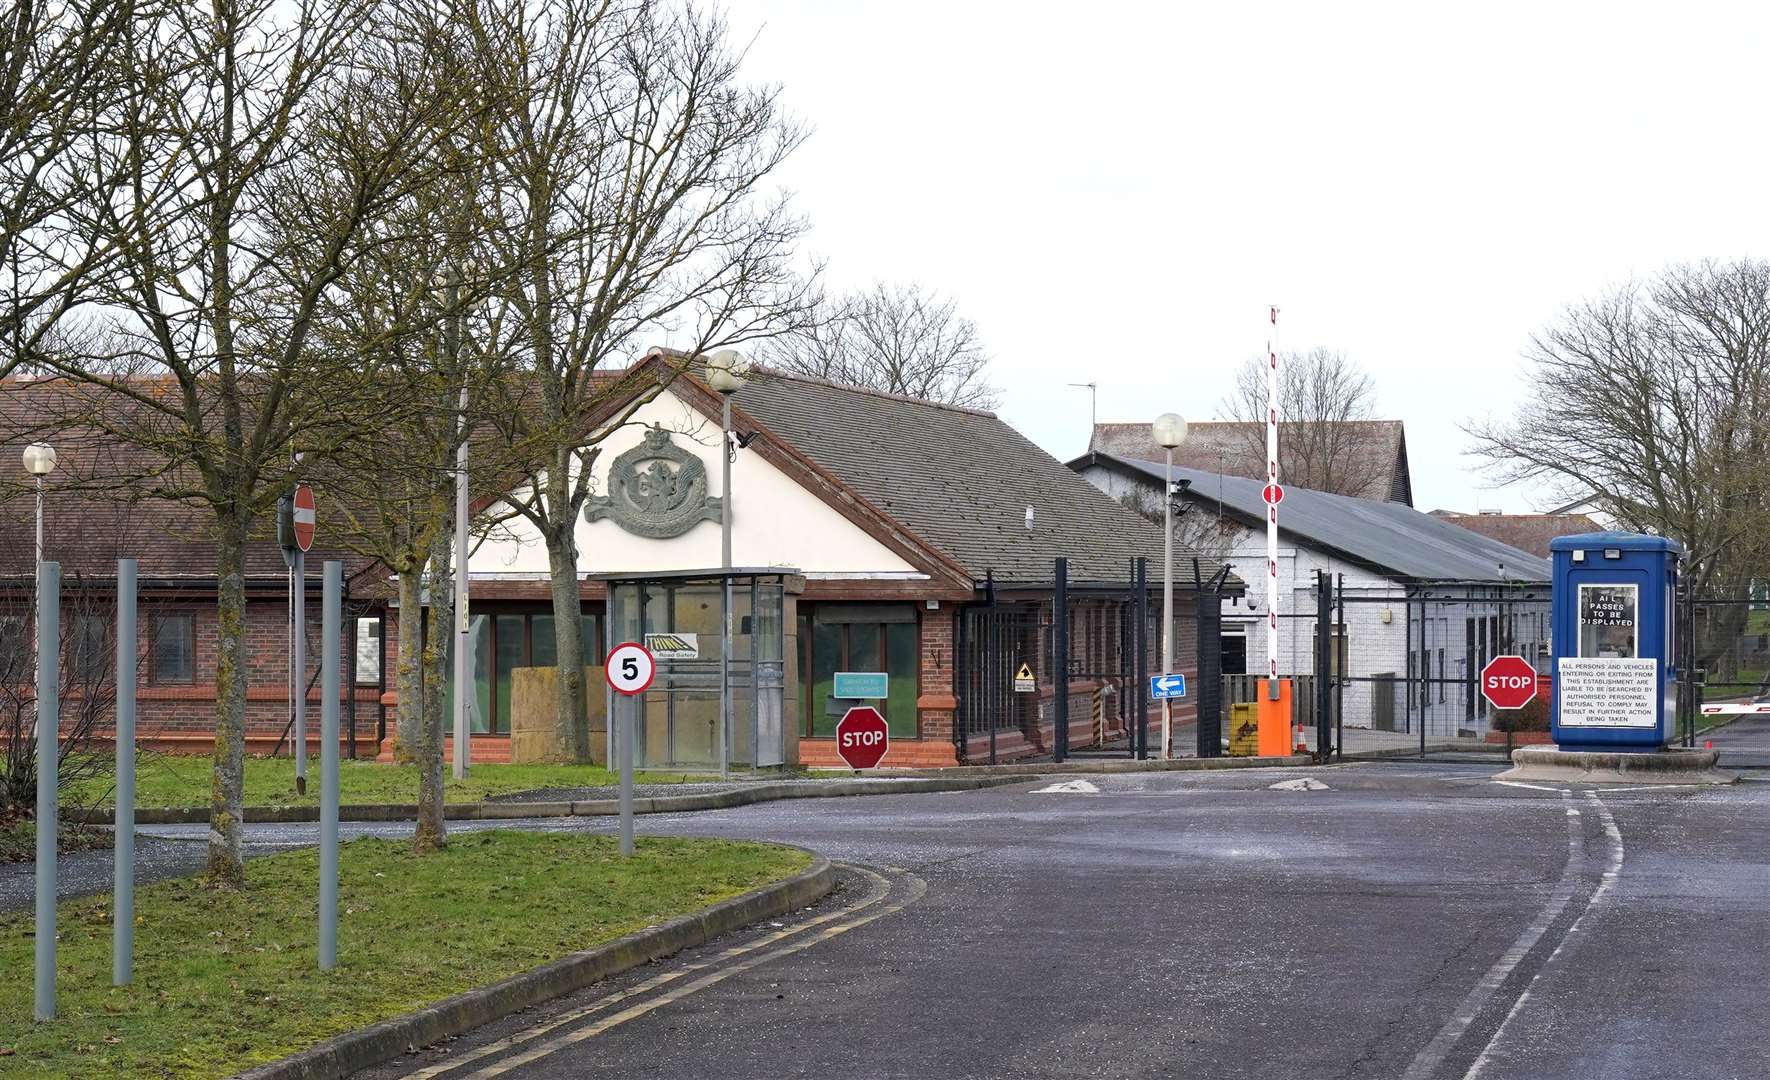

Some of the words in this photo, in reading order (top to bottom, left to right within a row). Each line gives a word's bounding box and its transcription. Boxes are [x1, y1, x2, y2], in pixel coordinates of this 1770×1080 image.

[1590, 603, 1624, 611] PASSES
[1581, 618, 1633, 626] DISPLAYED
[622, 657, 639, 681] 5
[1487, 675, 1532, 689] STOP
[843, 731, 883, 747] STOP
